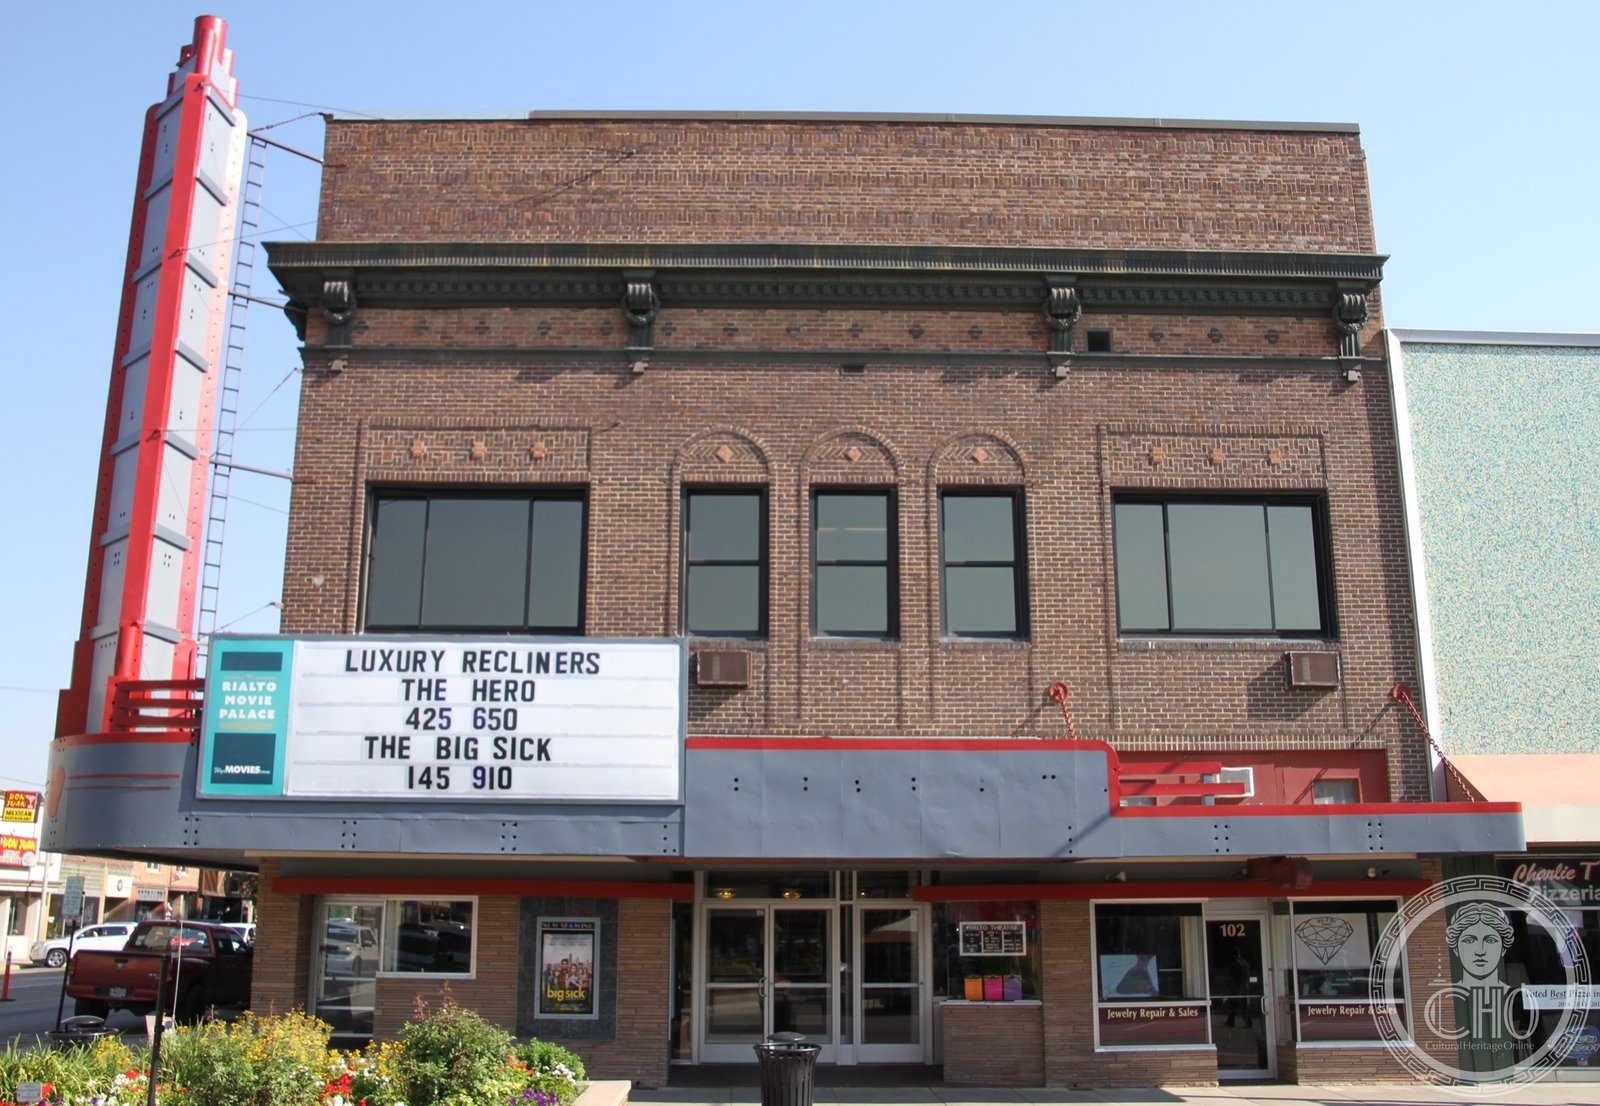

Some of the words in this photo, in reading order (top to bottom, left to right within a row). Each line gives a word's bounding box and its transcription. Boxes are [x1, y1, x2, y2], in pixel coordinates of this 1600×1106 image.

[345, 649, 446, 672] LUXURY
[462, 650, 600, 674] RECLINERS
[222, 681, 277, 692] RIALTO
[401, 679, 447, 701] THE
[472, 679, 536, 702] HERO
[224, 695, 272, 706] MOVIE
[219, 708, 275, 720] PALACE
[405, 707, 451, 731] 425
[472, 707, 518, 731] 650
[364, 736, 411, 760] THE
[436, 736, 479, 760] BIG
[493, 737, 552, 761] SICK
[408, 766, 450, 789] 145
[472, 766, 513, 790] 910
[1512, 863, 1576, 886] Charlie
[1219, 923, 1246, 937] 102
[547, 984, 564, 1001] big
[566, 985, 585, 998] sick
[1550, 989, 1567, 998] Best
[1107, 1008, 1137, 1020] Jewelry
[1140, 1008, 1166, 1020] Repair
[1169, 1008, 1175, 1017] &
[1178, 1007, 1198, 1017] Sales
[1308, 1005, 1336, 1016] Jewelry
[1340, 1005, 1365, 1016] Repair
[1368, 1006, 1374, 1015] &
[1377, 1005, 1397, 1015] Sales
